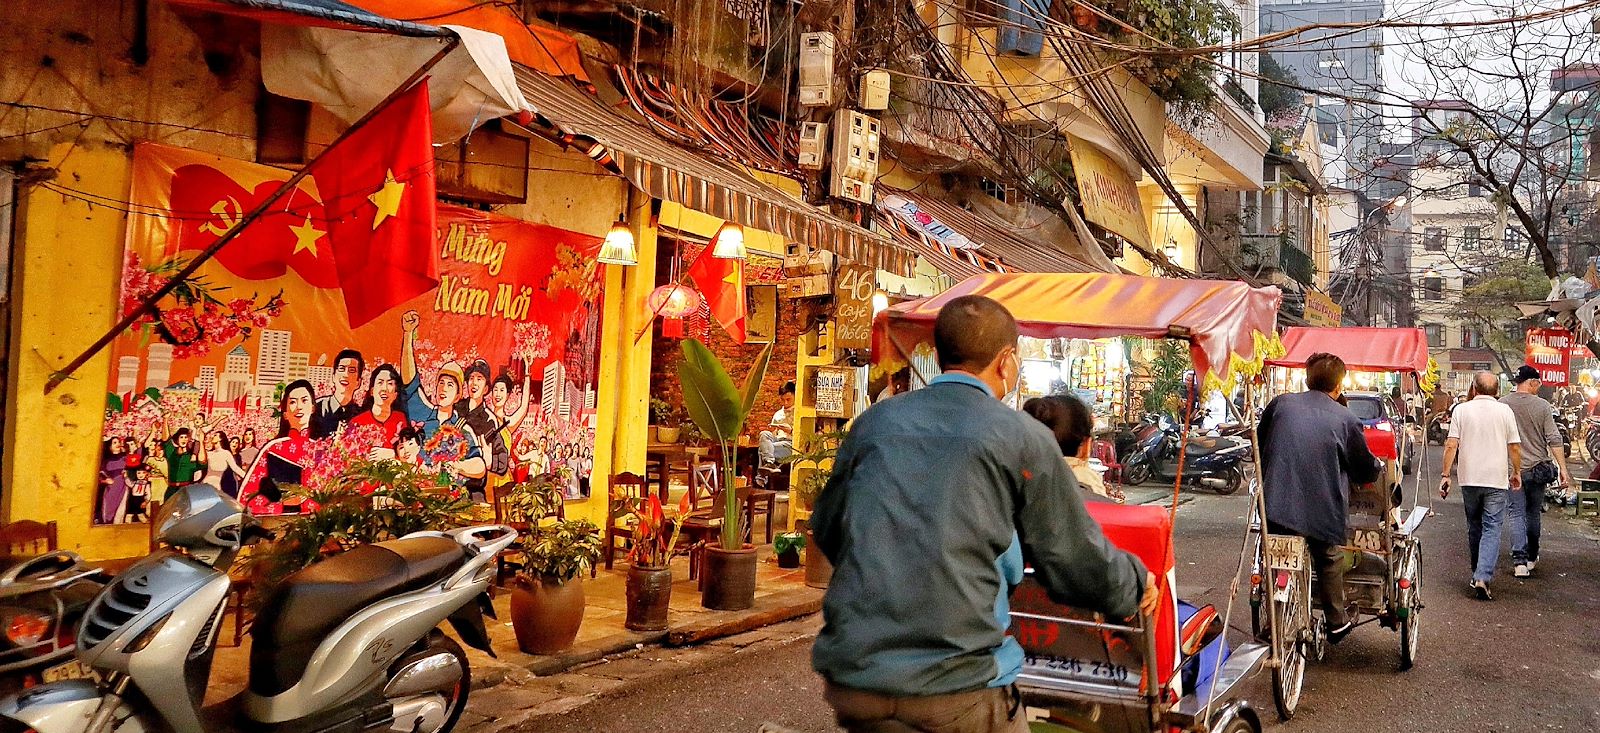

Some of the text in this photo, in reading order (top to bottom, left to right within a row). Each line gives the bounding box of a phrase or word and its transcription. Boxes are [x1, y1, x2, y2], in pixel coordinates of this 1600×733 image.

[441, 223, 507, 276] Mừng
[434, 275, 533, 321] Năm Mới
[839, 268, 873, 301] 46
[838, 301, 870, 322] Café
[1542, 370, 1565, 382] LONG
[1354, 530, 1381, 552] 48
